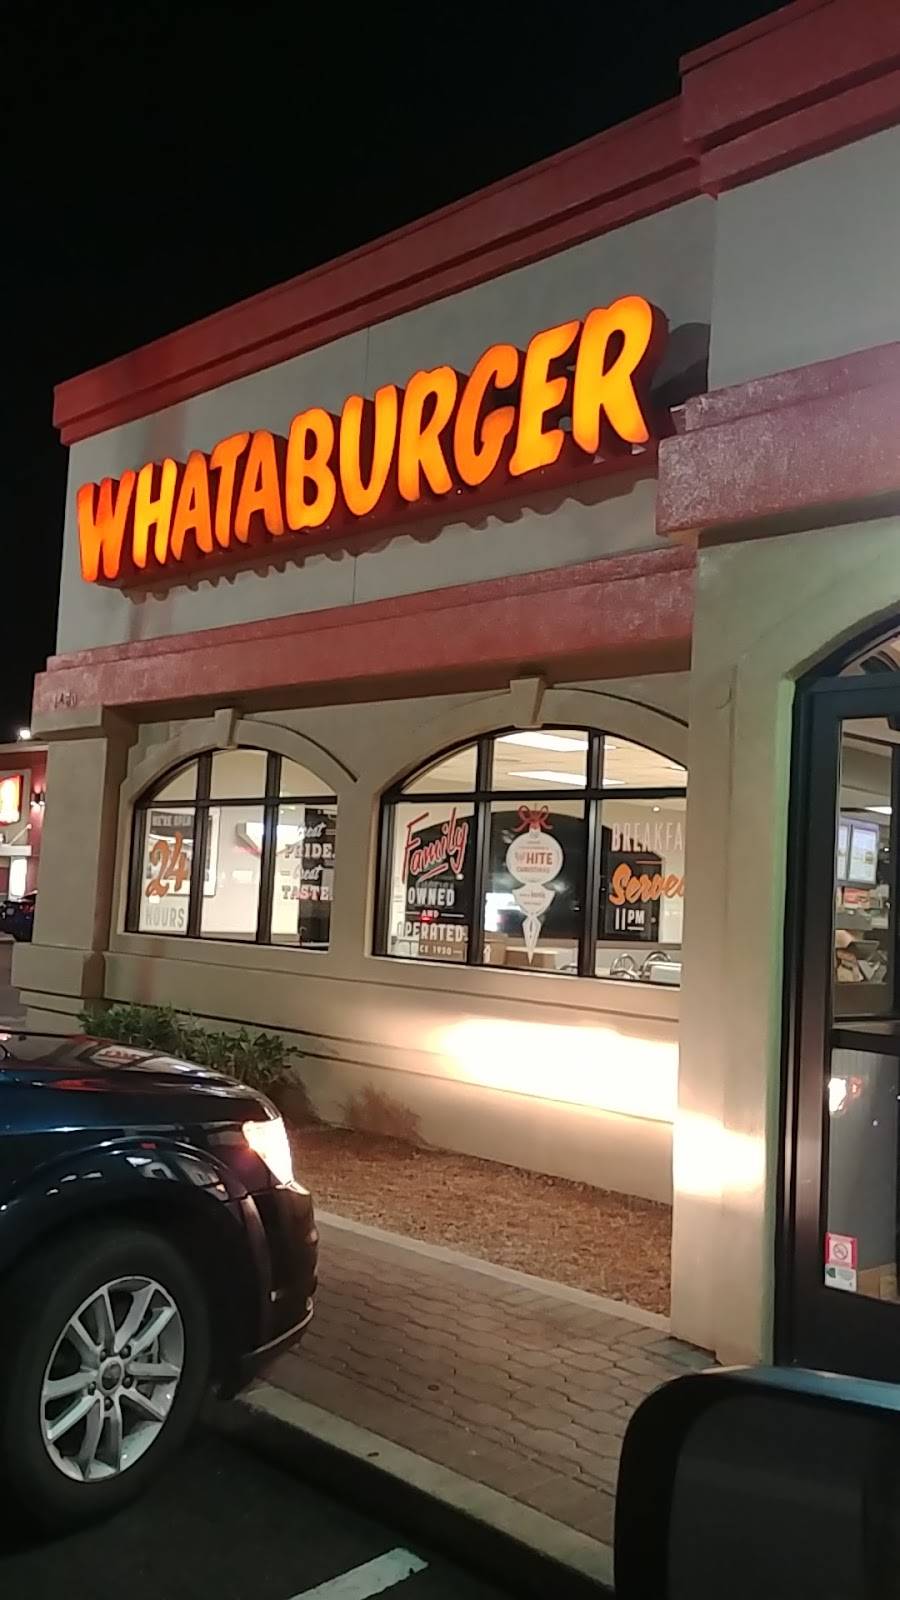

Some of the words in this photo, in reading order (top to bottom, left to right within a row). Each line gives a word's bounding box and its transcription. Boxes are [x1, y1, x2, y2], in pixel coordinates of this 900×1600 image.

[77, 295, 654, 583] WHATABURGER
[145, 831, 188, 898] 24
[401, 807, 469, 885] Family
[145, 907, 185, 929] HOURS
[407, 886, 455, 907] OWNED
